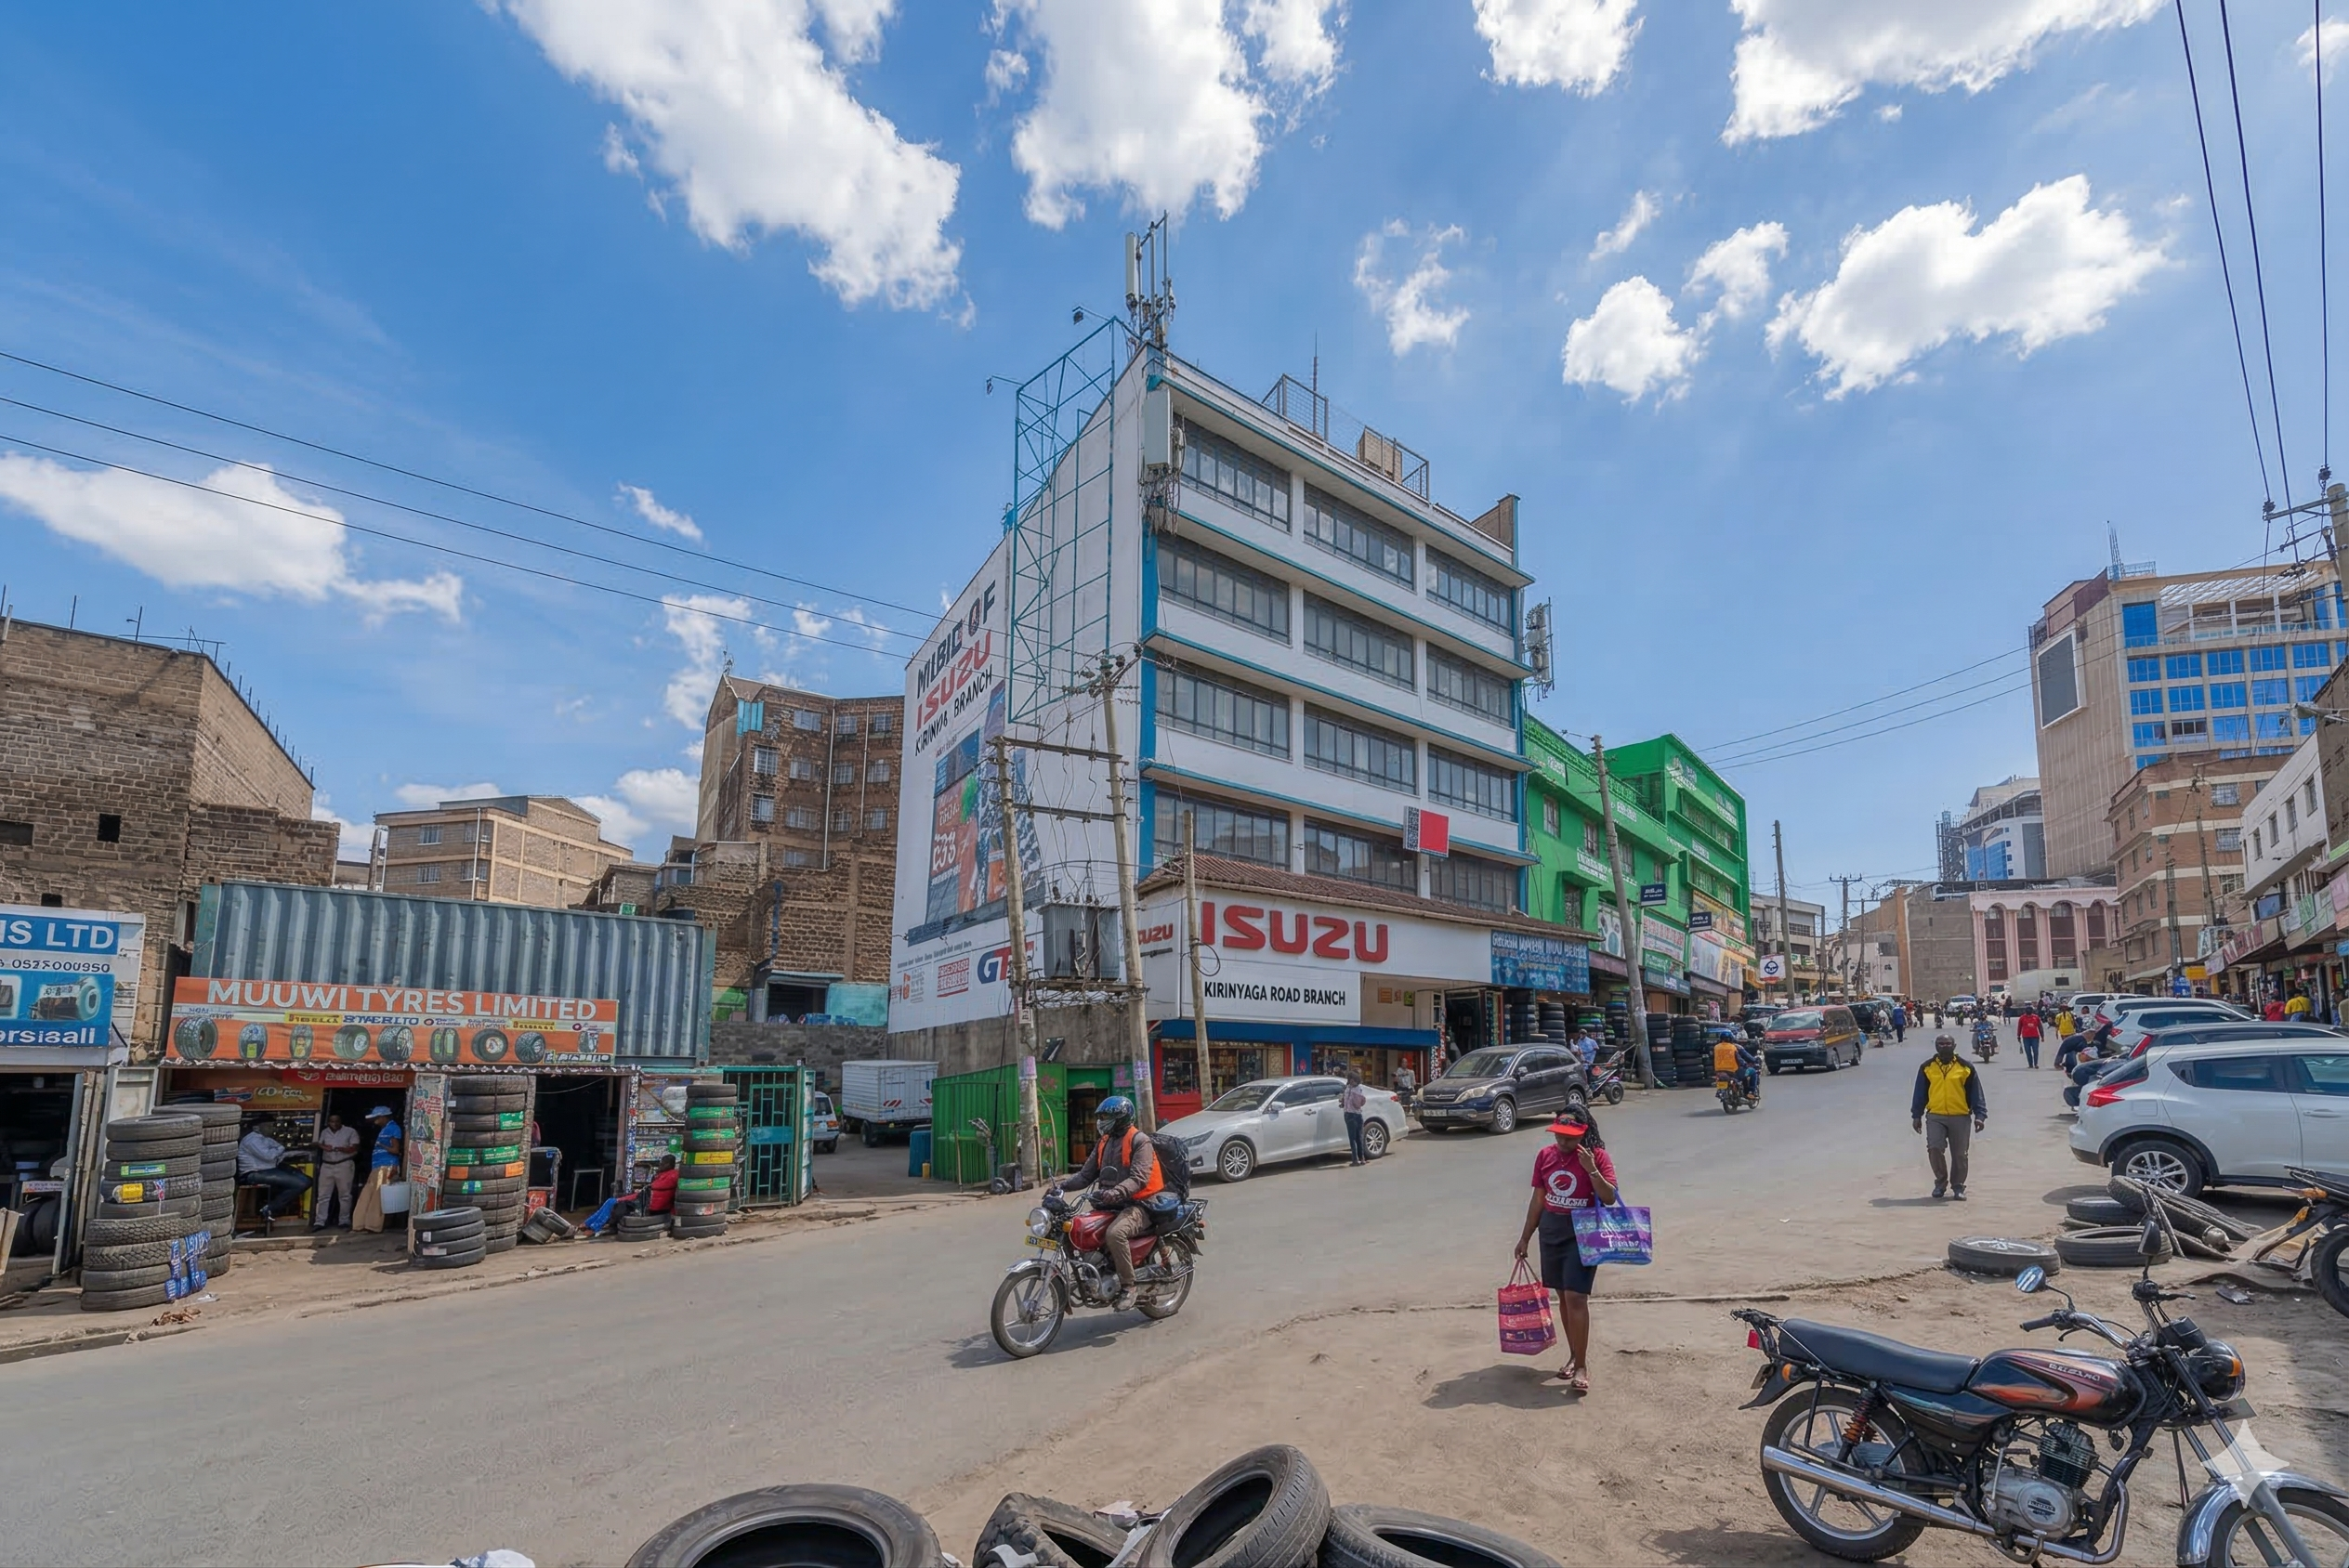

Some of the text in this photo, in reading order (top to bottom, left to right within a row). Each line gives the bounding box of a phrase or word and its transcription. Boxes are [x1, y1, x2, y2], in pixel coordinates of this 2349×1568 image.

[968, 580, 996, 636] OF
[916, 629, 991, 732] ISUZU
[953, 664, 993, 719] BRANCH
[46, 922, 114, 948] LTD
[1201, 901, 1388, 963] ISUZU
[207, 980, 597, 1020] MUUWI TYRES LIMITED
[1204, 981, 1345, 1006] KIRINYAGA ROAD BRANCH
